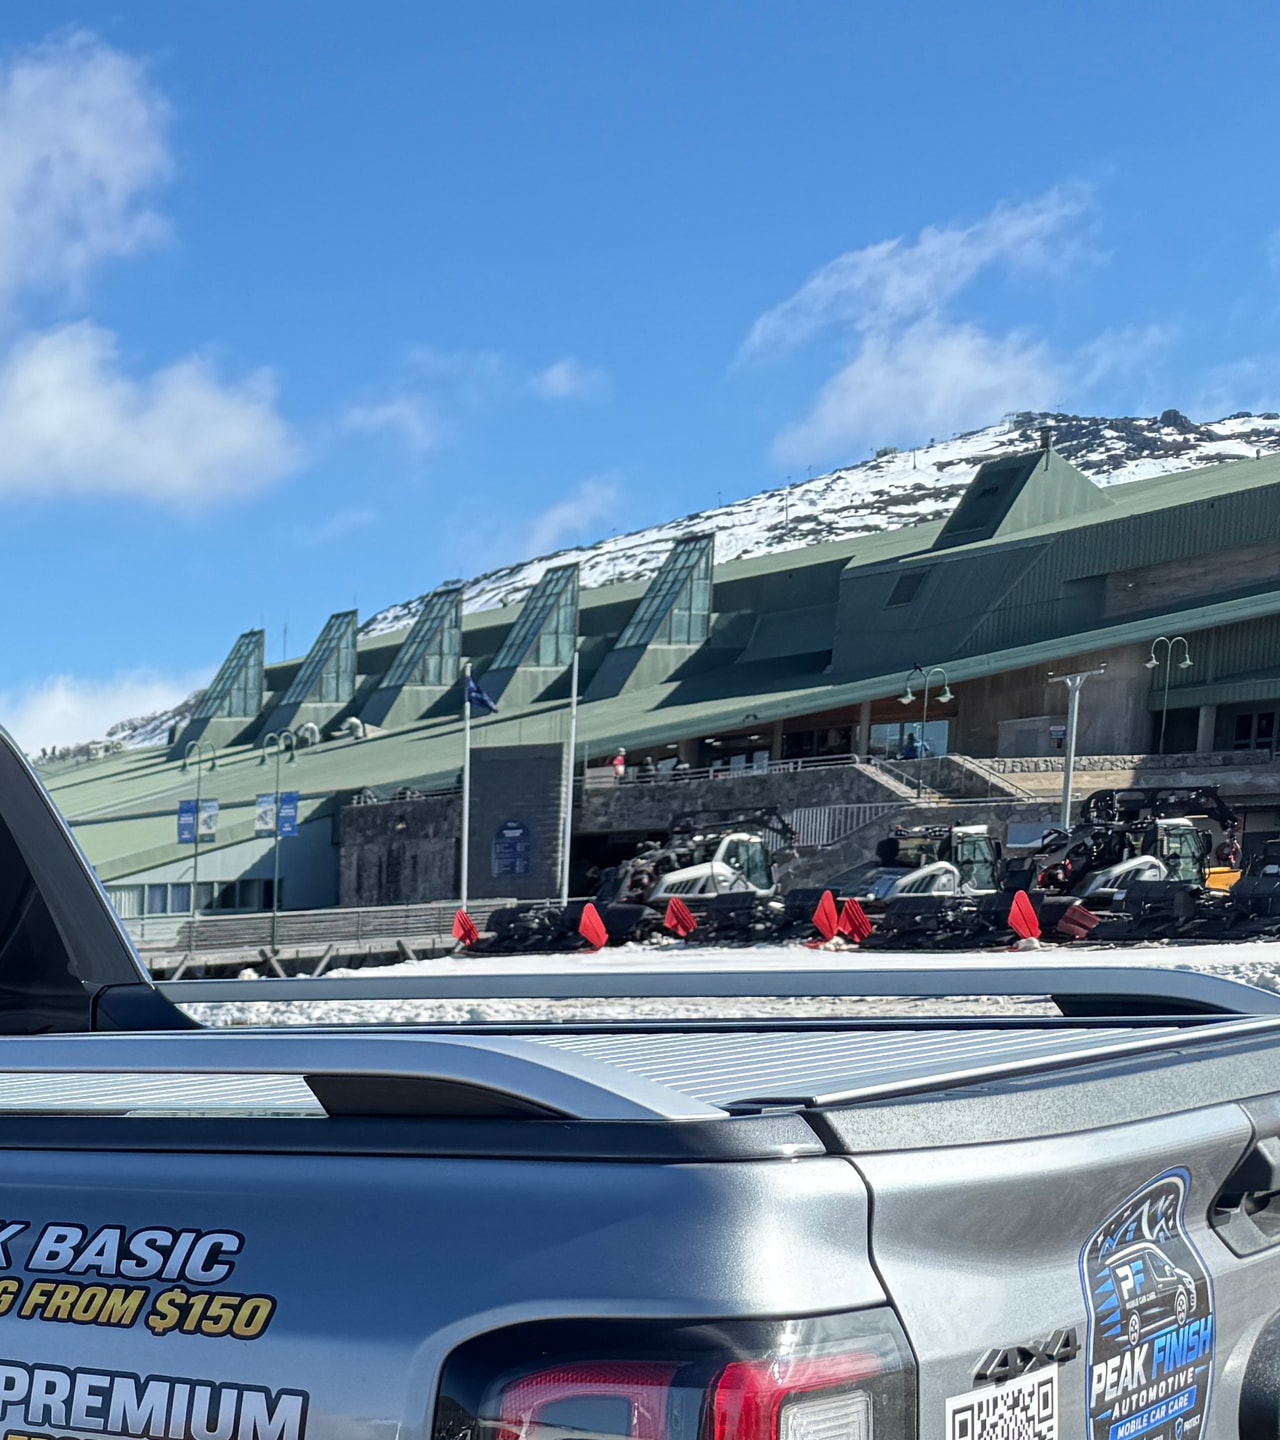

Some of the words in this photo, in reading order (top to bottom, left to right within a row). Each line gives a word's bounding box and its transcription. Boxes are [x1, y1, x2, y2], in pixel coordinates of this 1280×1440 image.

[32, 1223, 243, 1283] BASIC
[19, 1281, 141, 1326] FROM
[147, 1287, 274, 1340] $150
[1090, 1342, 1149, 1408] PEAK
[1152, 1314, 1213, 1380] FINISH
[1112, 1367, 1194, 1420] AUTOMOTIVE
[1117, 1416, 1148, 1439] MOBILE
[1150, 1406, 1166, 1423] CAR
[1168, 1393, 1189, 1414] CARE
